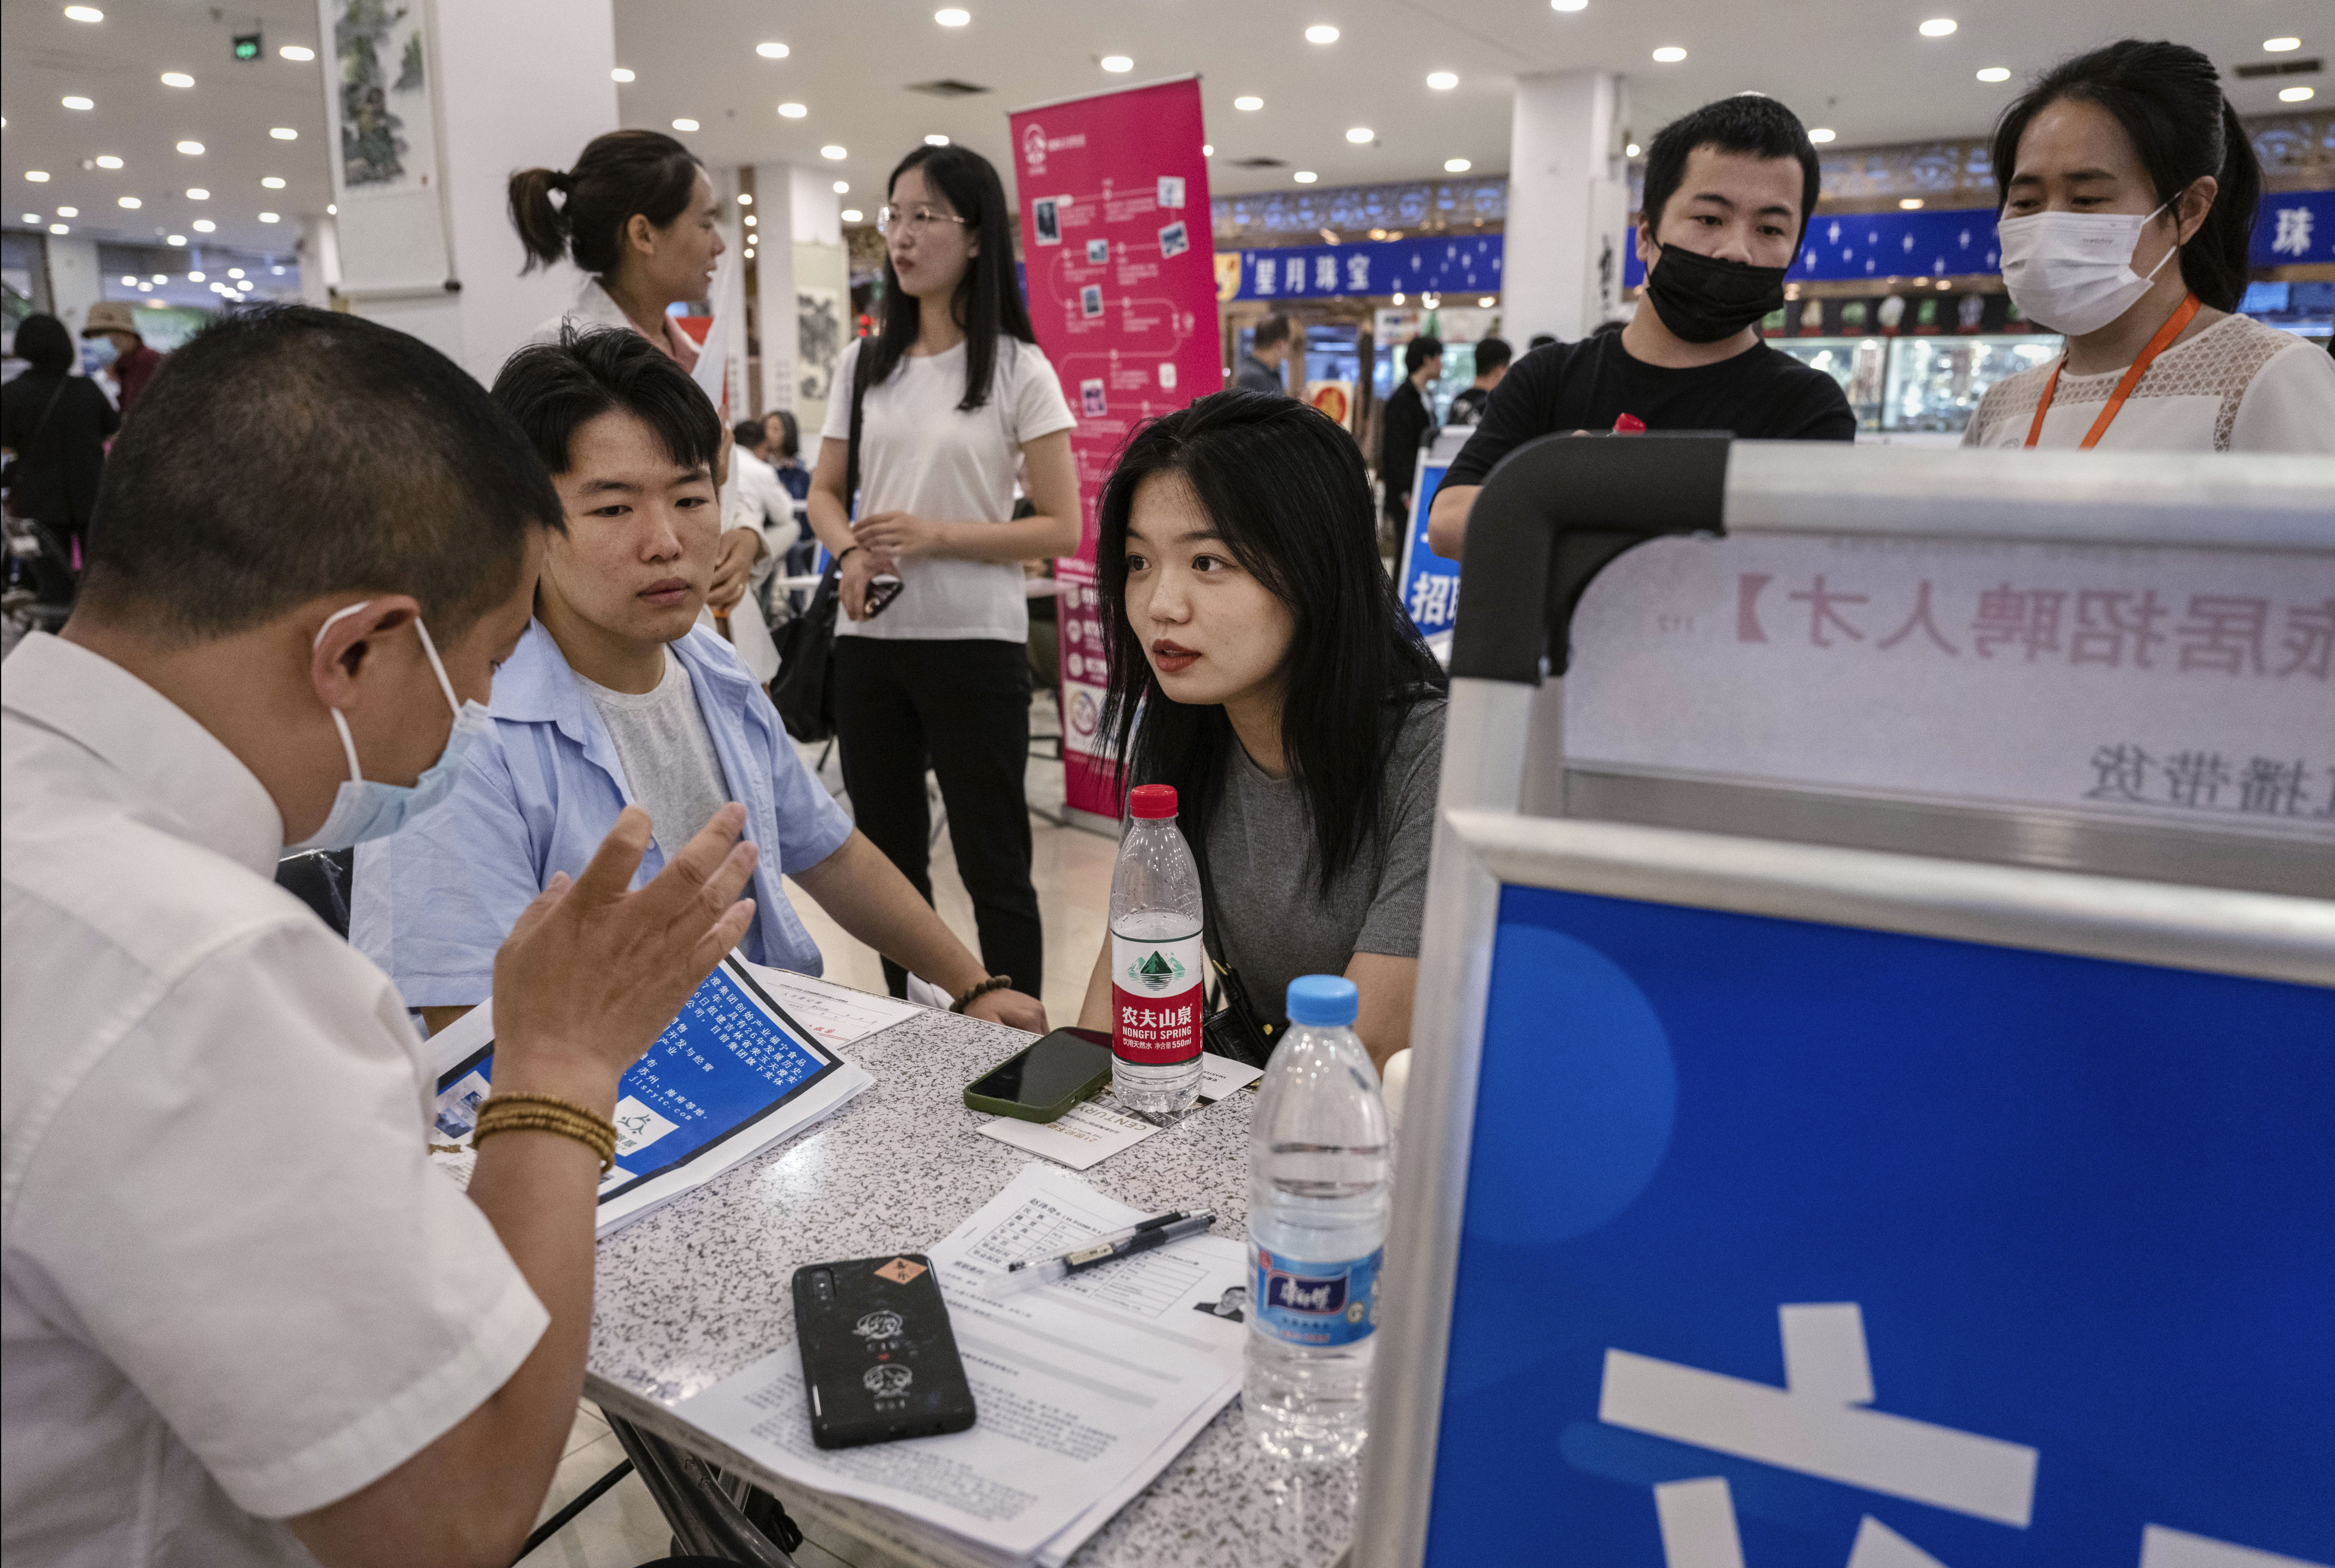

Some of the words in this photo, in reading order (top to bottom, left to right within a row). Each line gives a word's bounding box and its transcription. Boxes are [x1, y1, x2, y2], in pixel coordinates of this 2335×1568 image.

[1254, 253, 1371, 295] 星月珠宝
[706, 972, 807, 1067] 澄集团创始产业福宁食品
[1122, 1006, 1192, 1028] 农夫山泉
[1122, 1025, 1156, 1039] NONGFU
[1160, 1026, 1192, 1039] SPRING
[1123, 1038, 1152, 1050] 饮用天然水
[656, 1037, 677, 1056] 产业
[664, 1025, 714, 1072] 开发与经营
[1074, 1105, 1147, 1131] CENTURY
